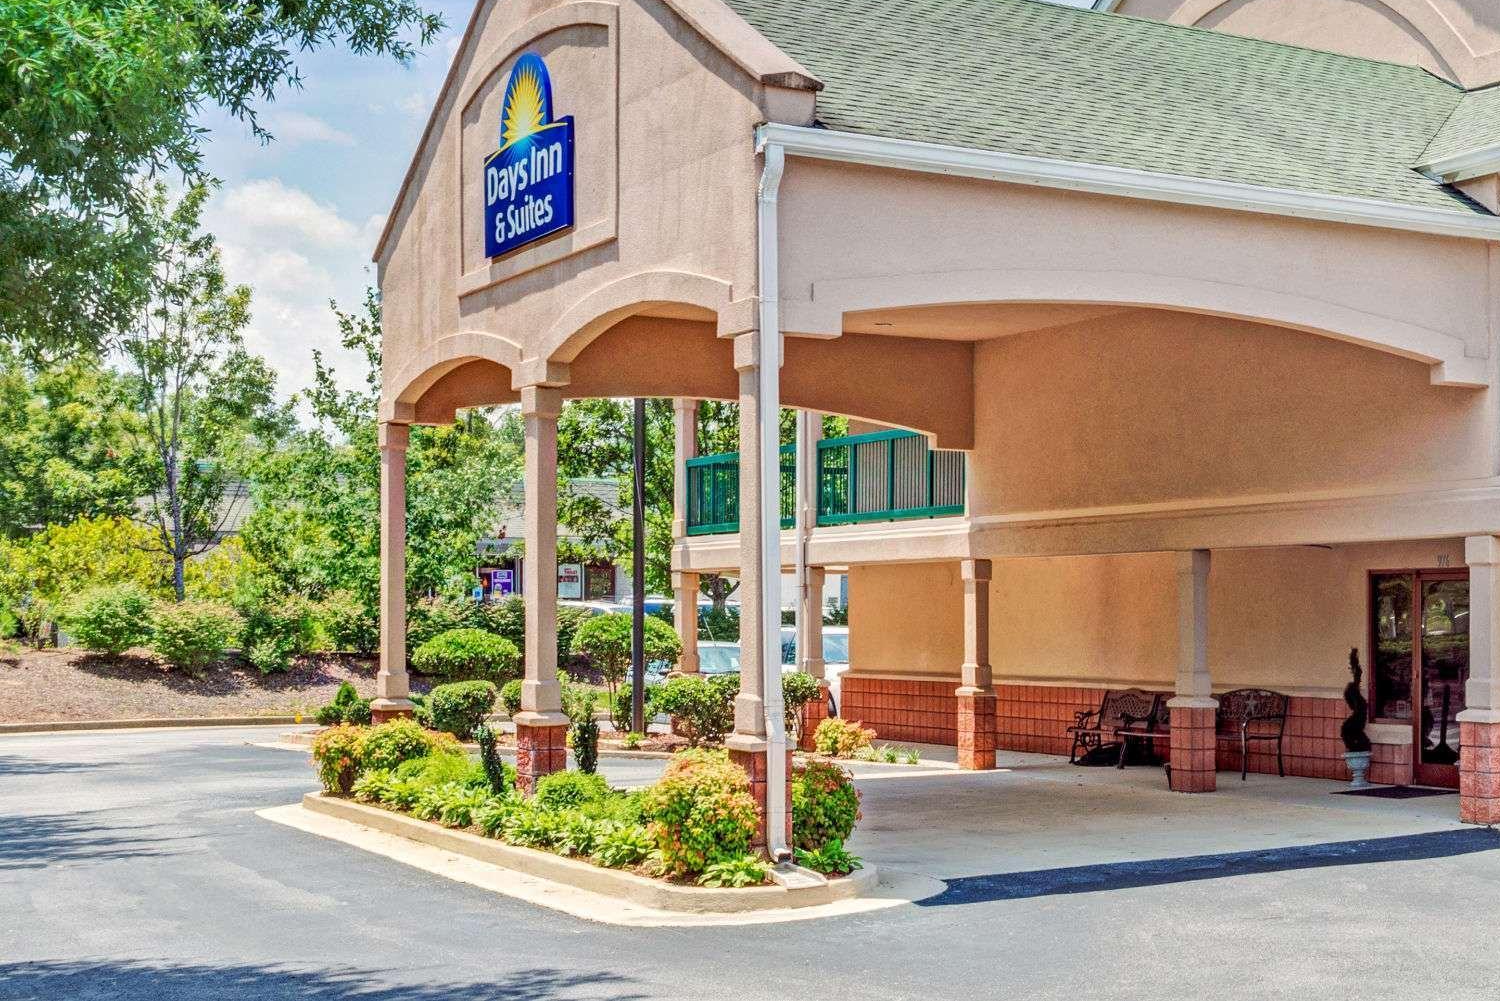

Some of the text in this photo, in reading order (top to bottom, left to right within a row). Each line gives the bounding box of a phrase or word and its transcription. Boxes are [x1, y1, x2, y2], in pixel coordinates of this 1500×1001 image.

[487, 142, 562, 207] Days Inn
[495, 194, 553, 244] & Suites
